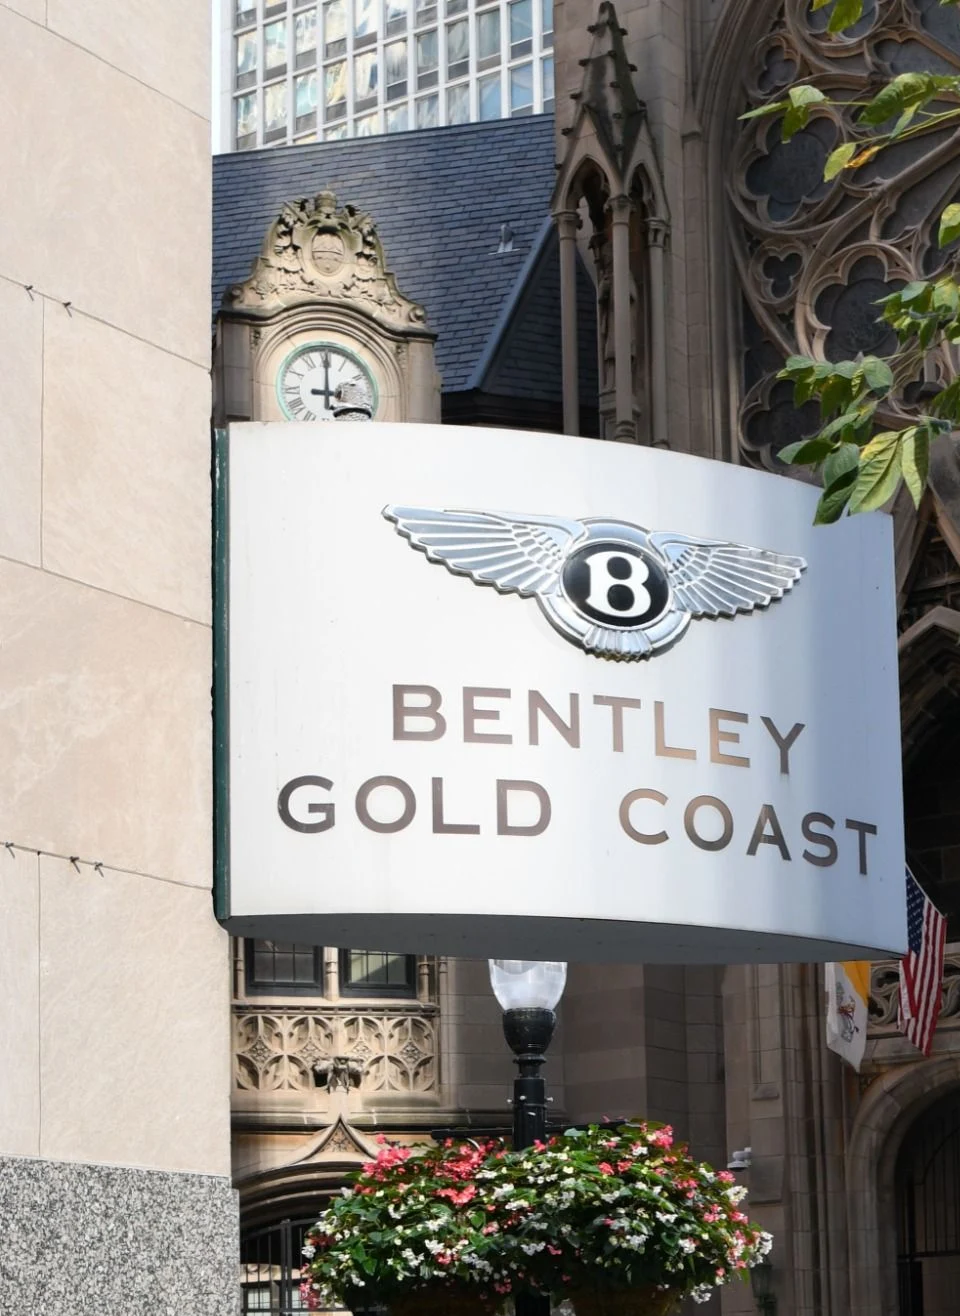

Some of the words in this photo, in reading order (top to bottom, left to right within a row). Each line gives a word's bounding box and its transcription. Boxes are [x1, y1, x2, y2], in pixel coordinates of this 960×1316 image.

[585, 550, 652, 618] B
[391, 683, 806, 775] BENTLEY
[277, 775, 552, 837] GOLD
[618, 788, 878, 876] COAST
